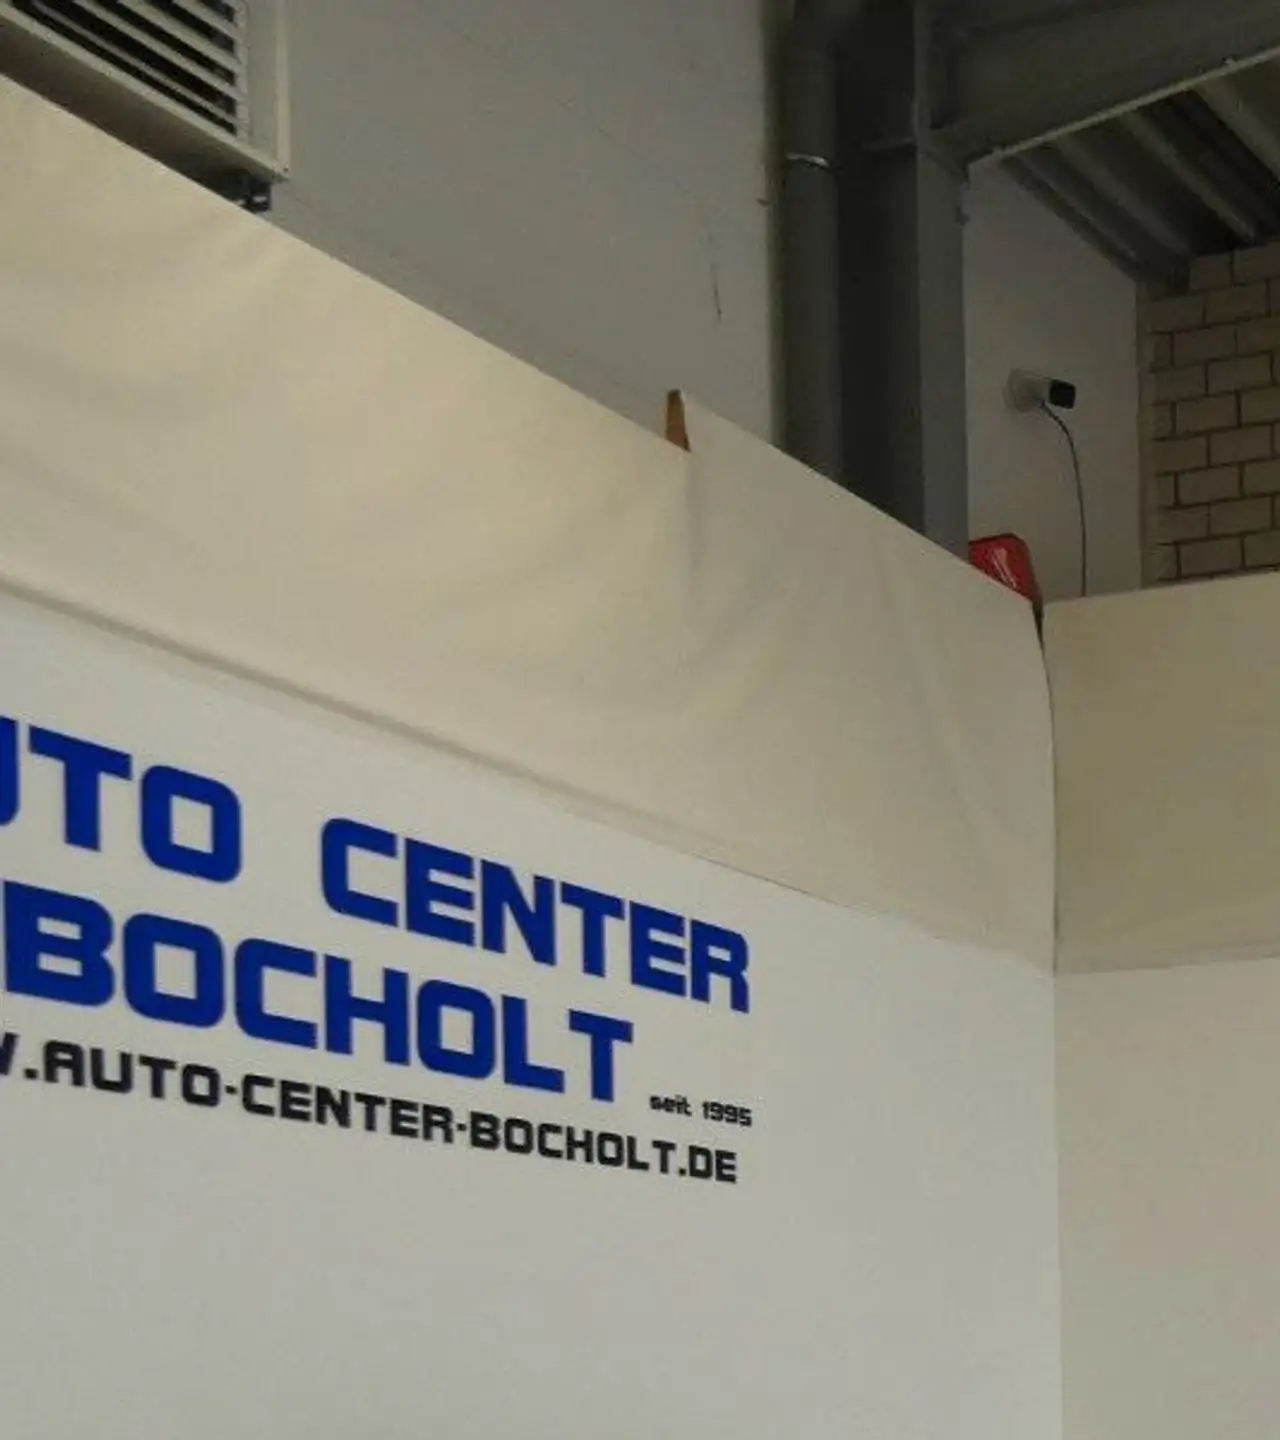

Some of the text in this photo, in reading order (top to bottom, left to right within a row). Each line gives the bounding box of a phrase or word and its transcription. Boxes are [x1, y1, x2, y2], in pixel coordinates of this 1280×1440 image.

[0, 714, 750, 1012] TO CENTER
[2, 880, 633, 1101] BOCHOLT
[648, 1094, 753, 1128] seit 1995
